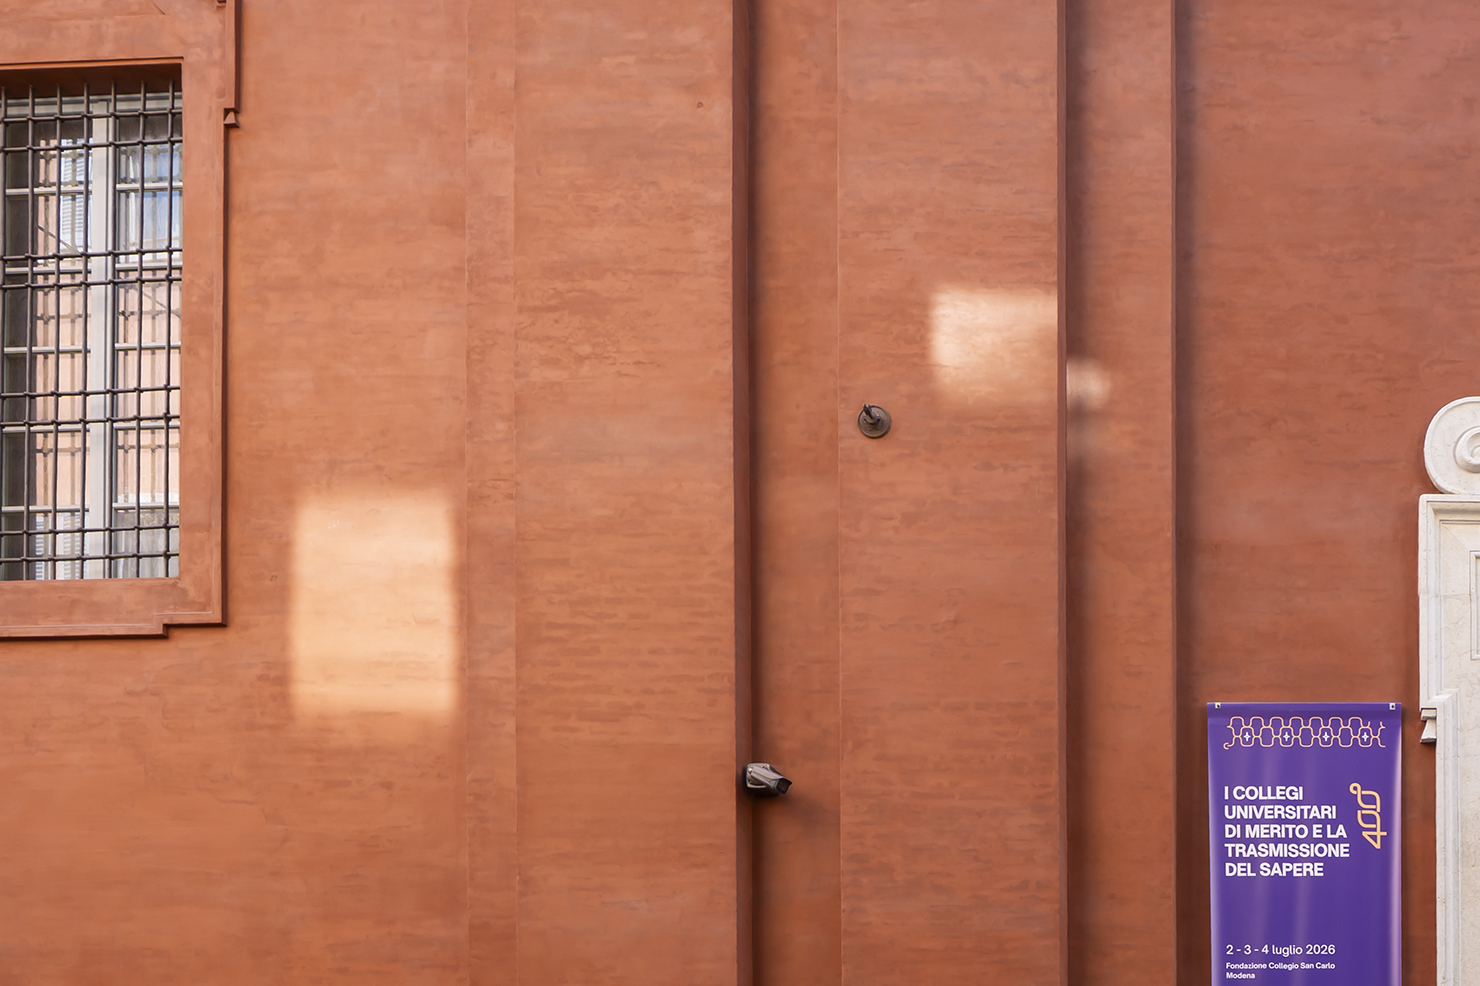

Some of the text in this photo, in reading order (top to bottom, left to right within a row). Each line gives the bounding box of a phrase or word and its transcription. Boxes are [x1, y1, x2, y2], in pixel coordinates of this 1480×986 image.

[1224, 786, 1303, 800] I COLLEGI
[1224, 805, 1336, 819] UNIVERSITARI
[1225, 824, 1347, 838] DI MERITO E LA
[1224, 843, 1350, 858] TRASMISSIONE
[1225, 862, 1324, 877] DEL SAPERE
[1226, 944, 1234, 955] 2
[1244, 944, 1252, 955] 3
[1261, 944, 1269, 955] 4
[1272, 944, 1303, 957] luglio
[1305, 944, 1336, 955] 2026
[1226, 962, 1336, 971] Fondazione Collegio San Carlo
